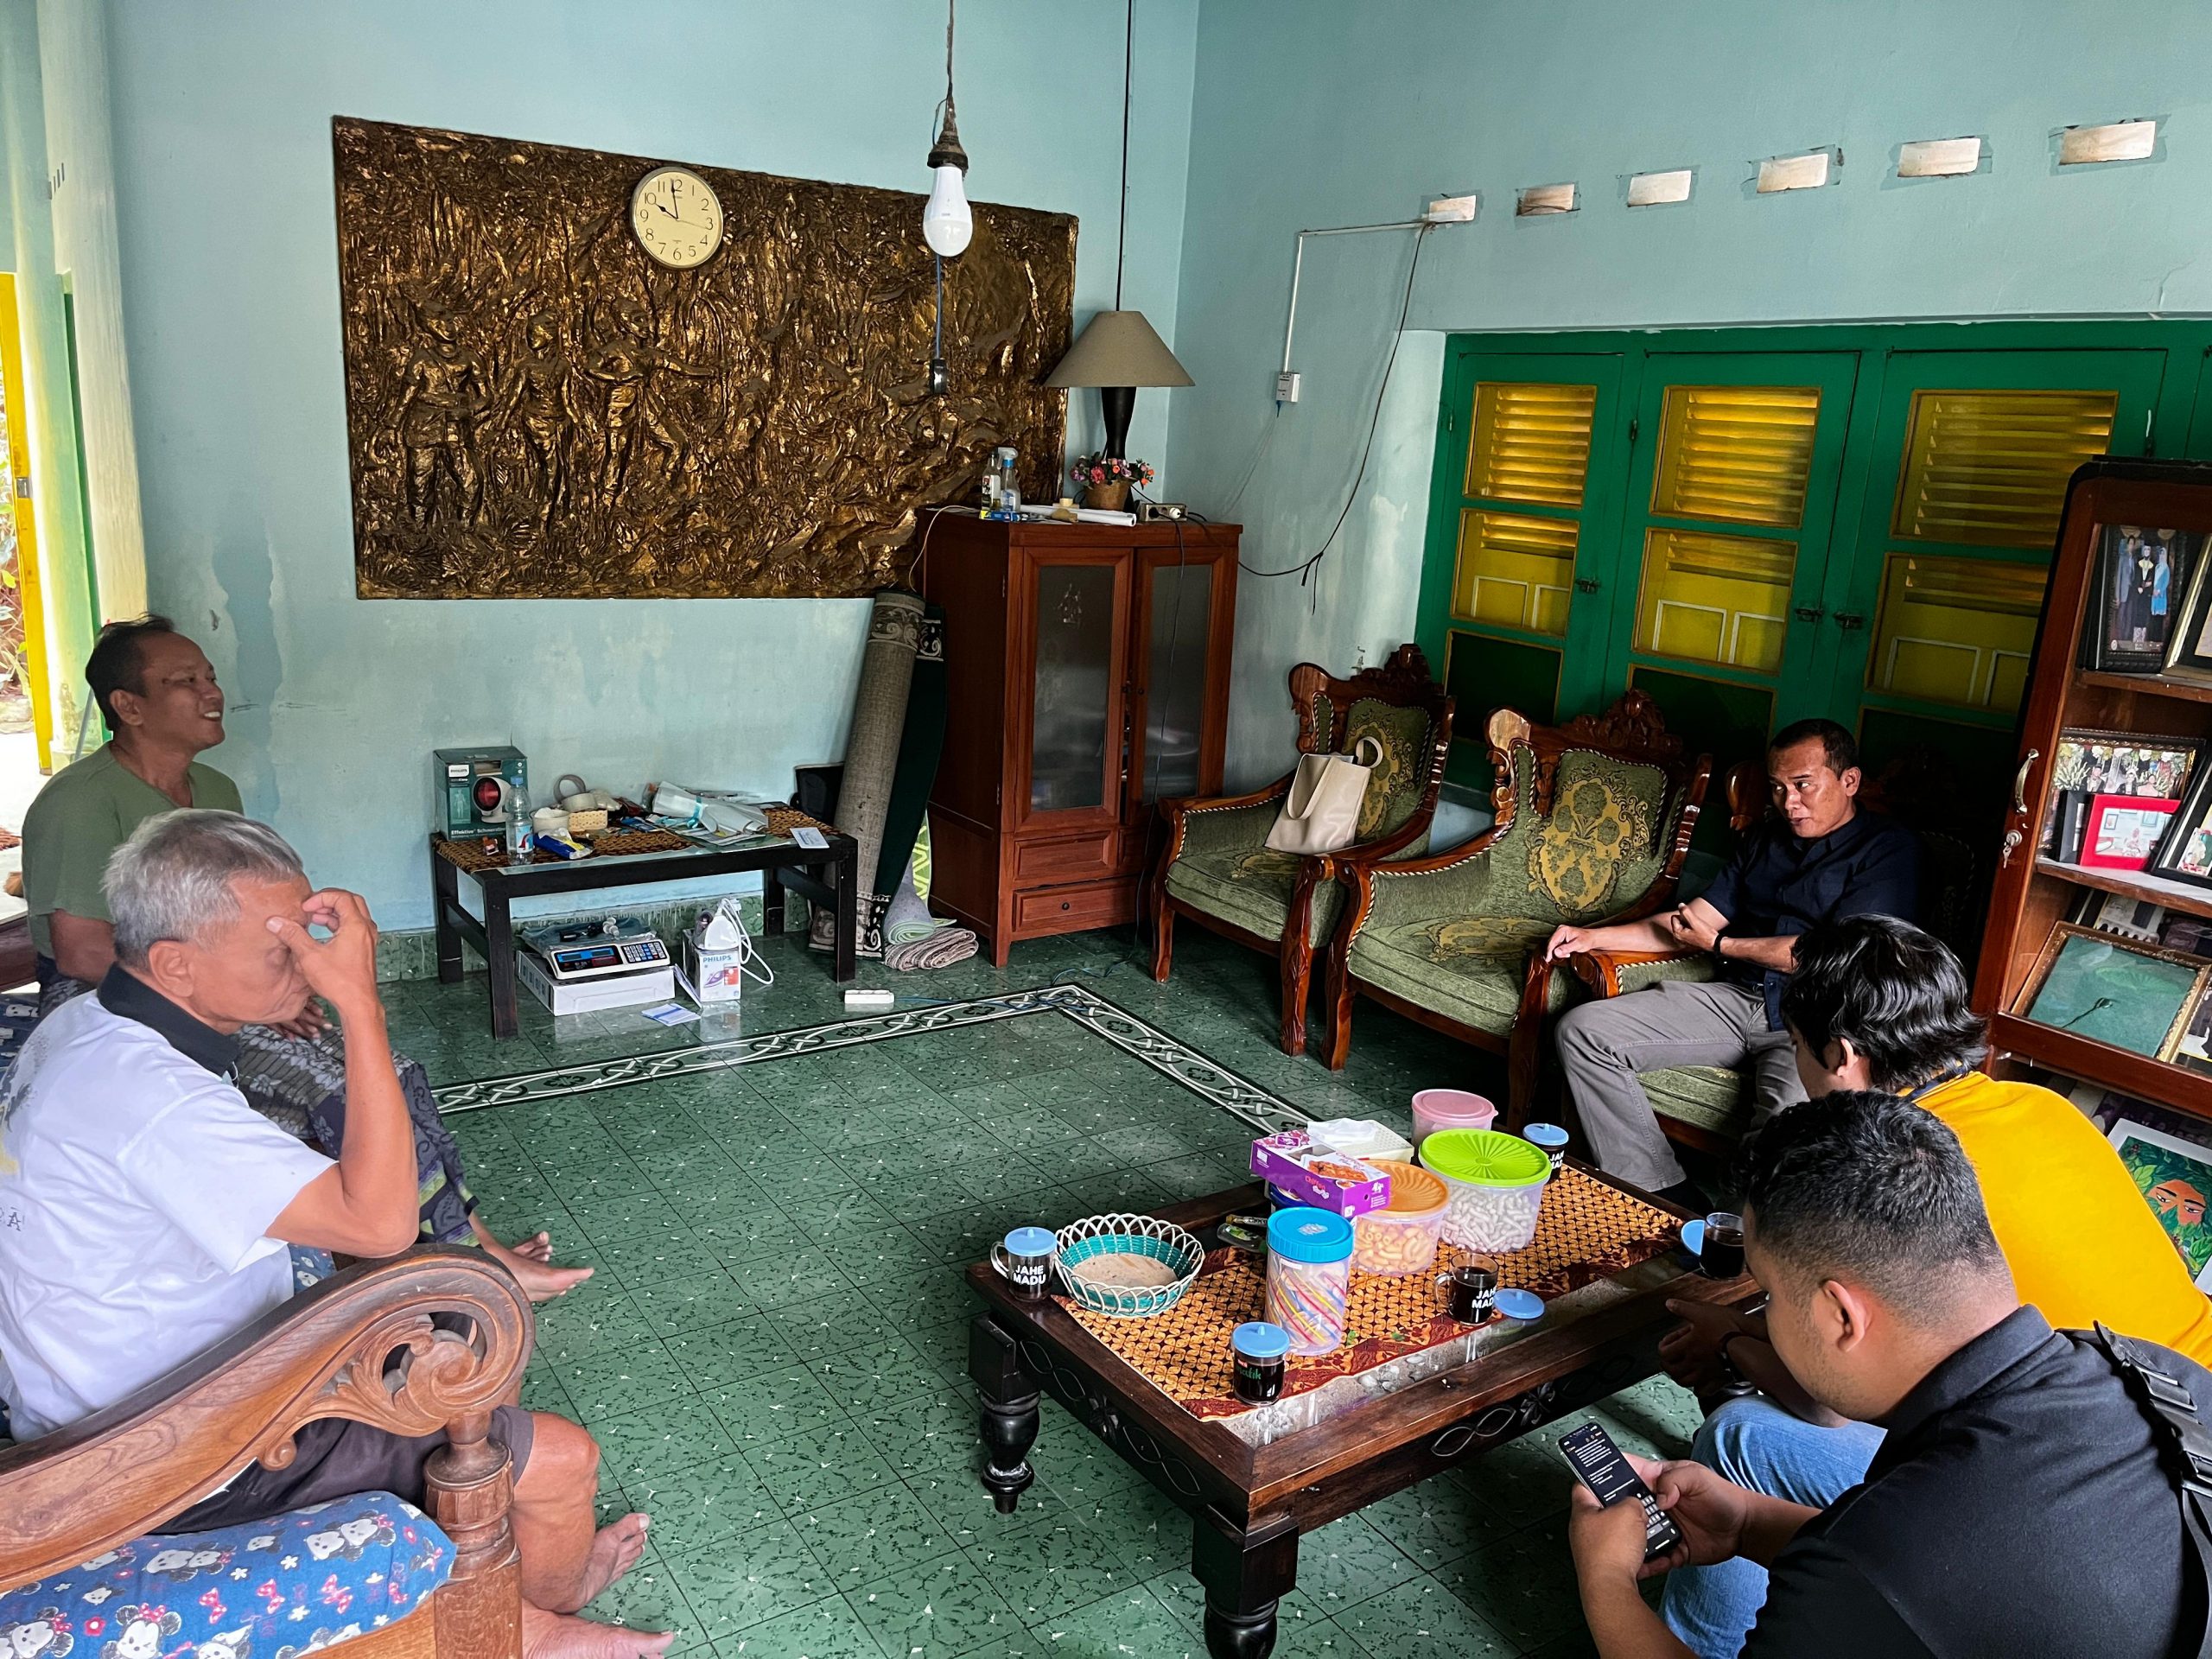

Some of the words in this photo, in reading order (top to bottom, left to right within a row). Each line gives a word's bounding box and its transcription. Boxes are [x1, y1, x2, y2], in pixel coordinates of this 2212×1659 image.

[644, 192, 657, 205] 10
[701, 198, 709, 211] 2
[639, 209, 649, 222] 9
[705, 217, 714, 231] 3
[645, 227, 654, 241] 8
[699, 234, 709, 245] 4
[658, 241, 666, 254] 7
[672, 247, 682, 261] 6
[688, 245, 696, 257] 5
[1550, 1150, 1565, 1162] JAH
[1015, 1264, 1045, 1276] JAHE
[1013, 1273, 1046, 1286] MADU
[1476, 1285, 1497, 1300] JAH
[1471, 1297, 1494, 1309] MAD
